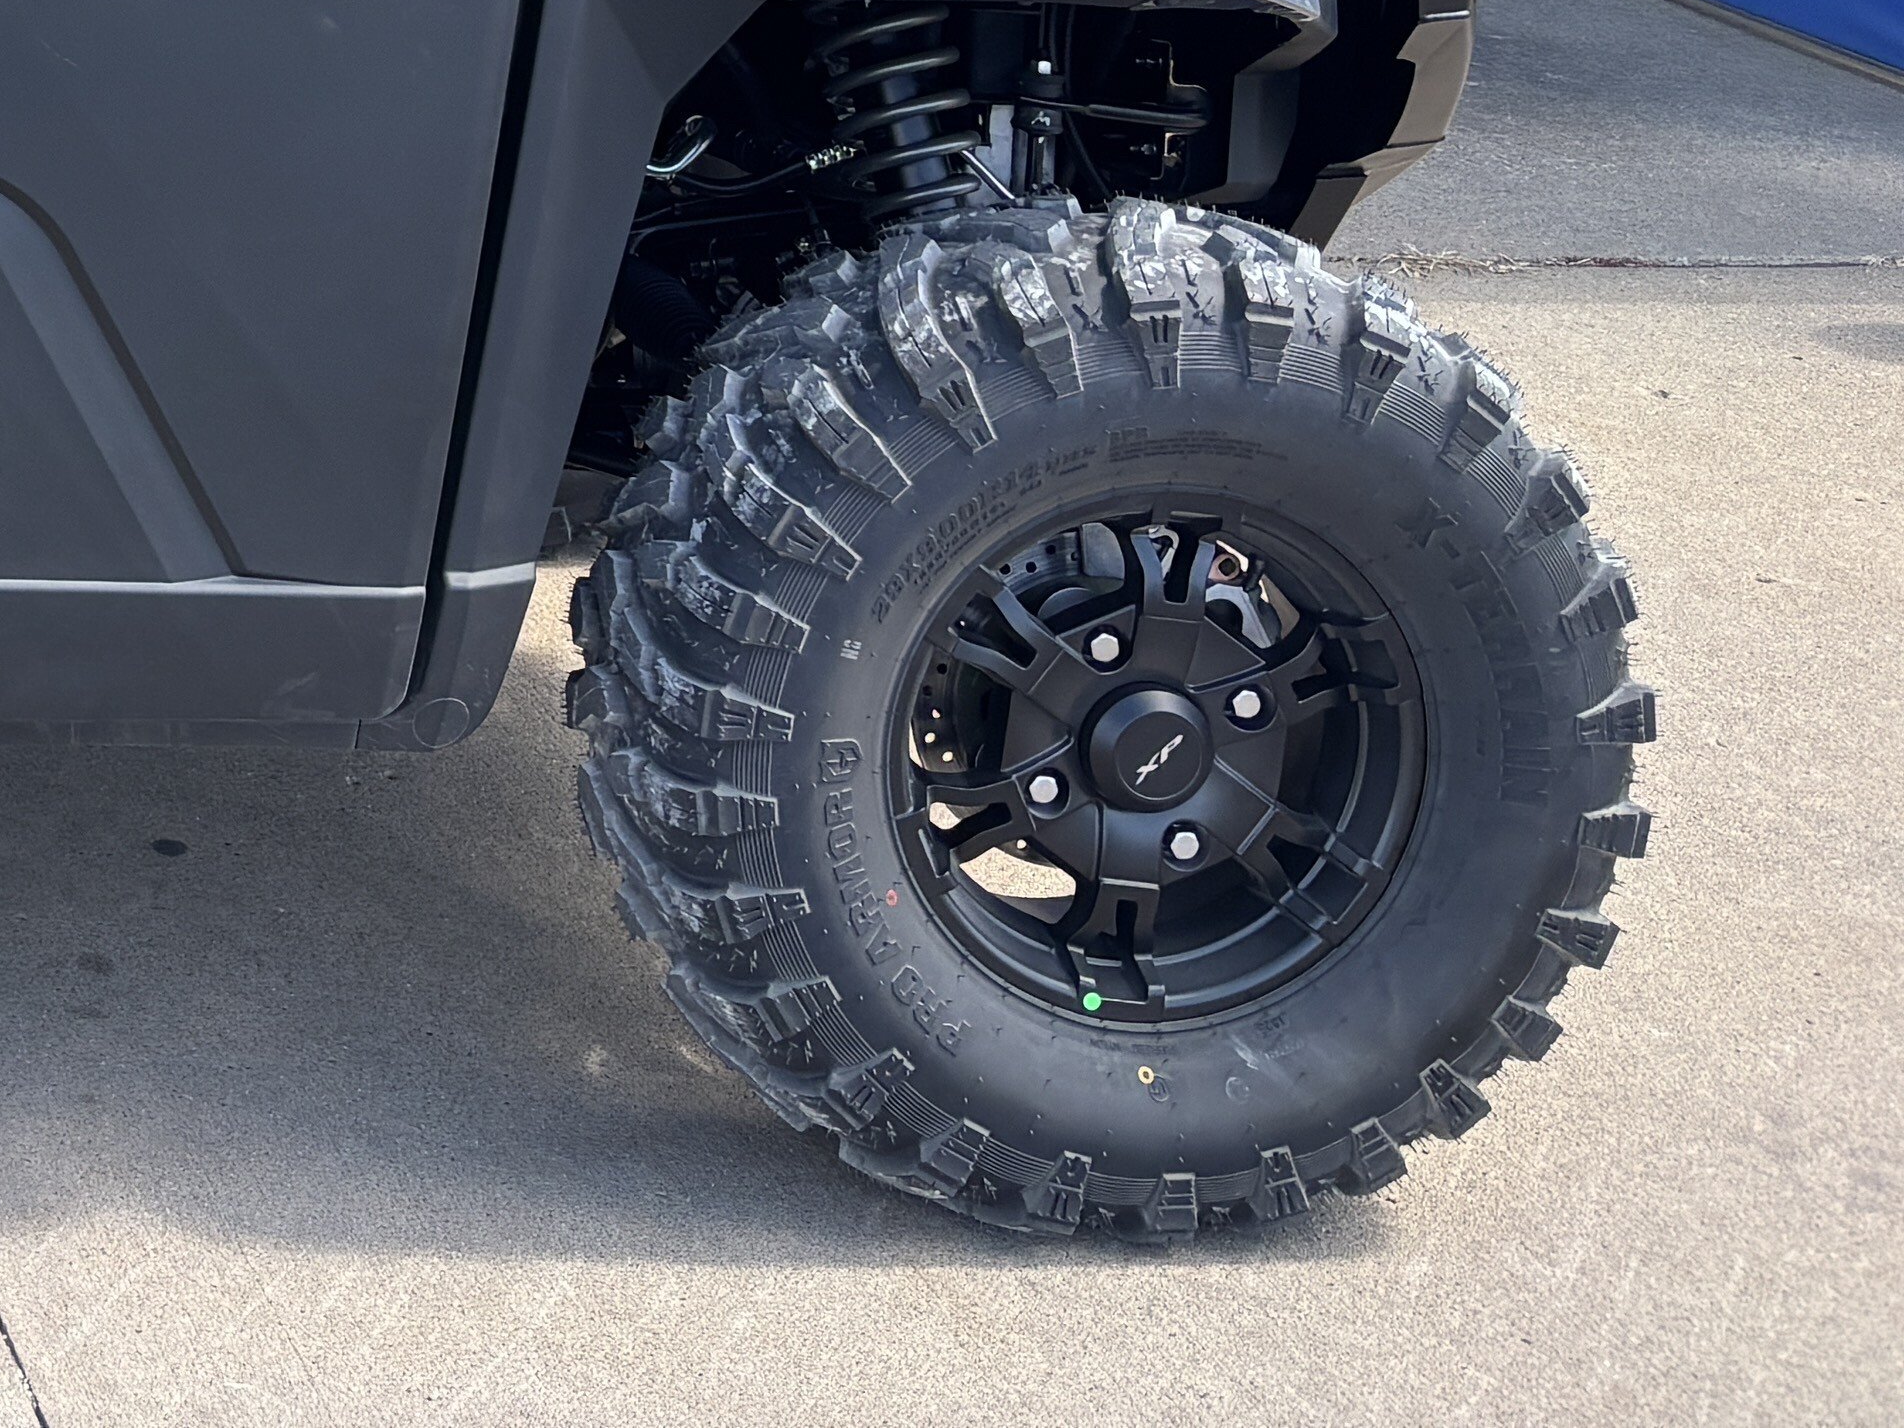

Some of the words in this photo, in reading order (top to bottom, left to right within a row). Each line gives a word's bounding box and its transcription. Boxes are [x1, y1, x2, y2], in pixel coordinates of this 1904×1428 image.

[1135, 734, 1185, 786] XP
[823, 786, 904, 966] ARMOR
[890, 963, 974, 1059] PRO
